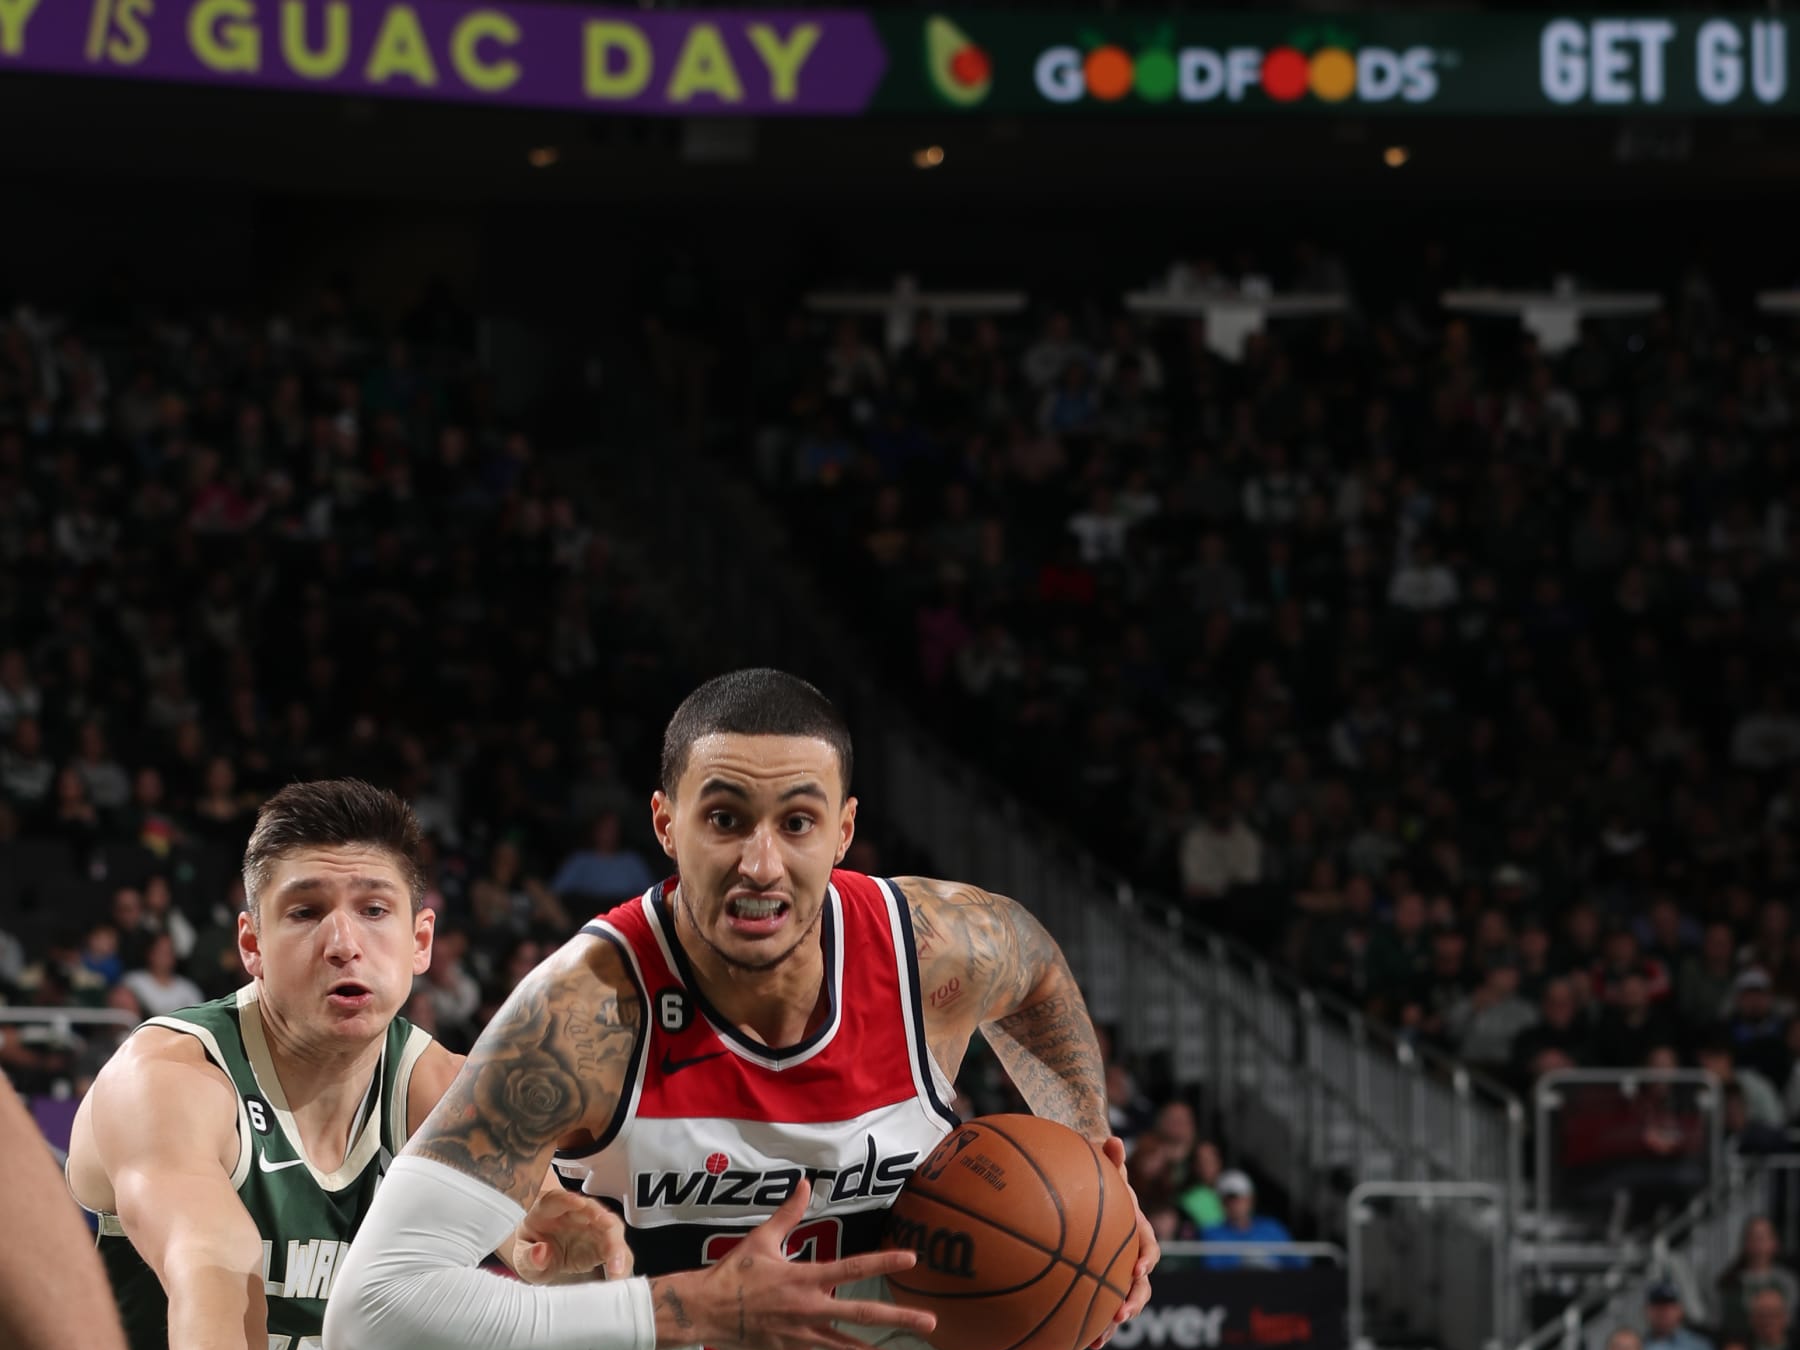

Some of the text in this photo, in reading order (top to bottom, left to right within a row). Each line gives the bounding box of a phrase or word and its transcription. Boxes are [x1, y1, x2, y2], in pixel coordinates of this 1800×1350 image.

[85, 0, 154, 64] IS
[187, 0, 523, 93] GUAC
[581, 21, 822, 104] DAY
[1034, 45, 1440, 103] GOODFOODS
[1539, 19, 1674, 104] GET
[661, 993, 684, 1029] 6
[247, 1101, 269, 1132] 6
[635, 1129, 921, 1209] wizards
